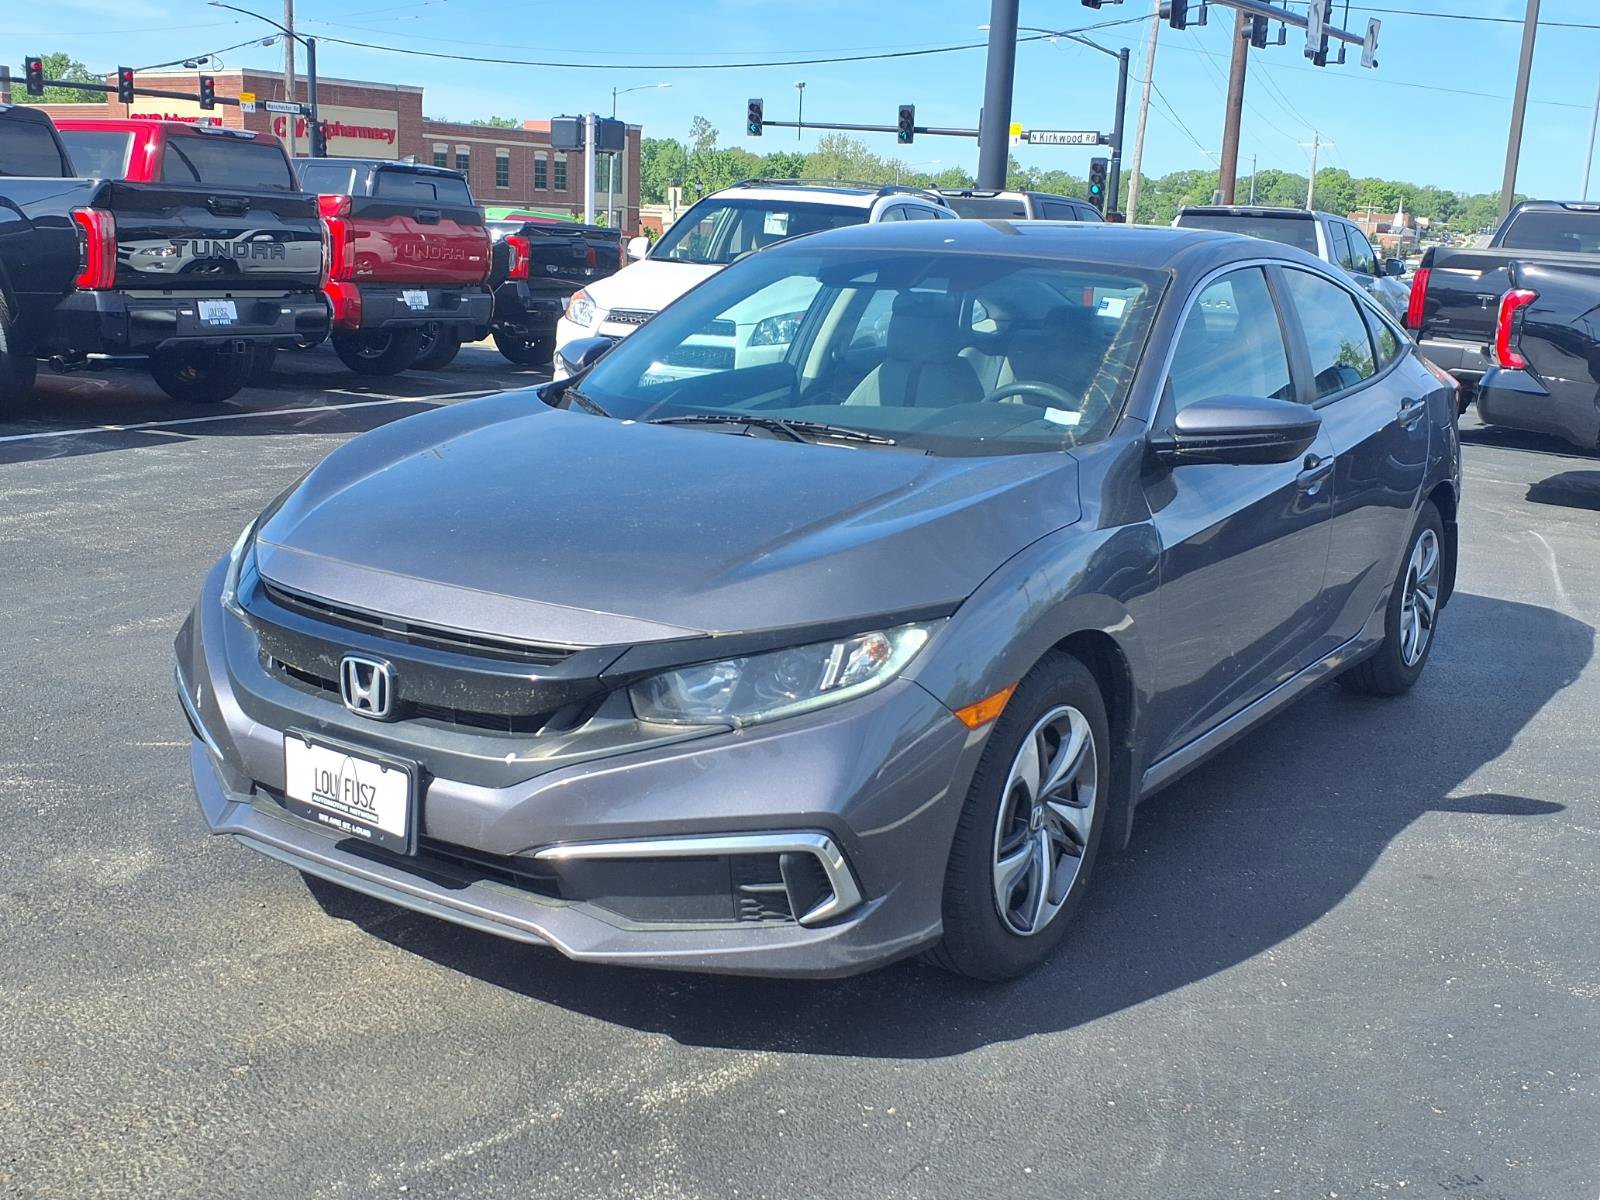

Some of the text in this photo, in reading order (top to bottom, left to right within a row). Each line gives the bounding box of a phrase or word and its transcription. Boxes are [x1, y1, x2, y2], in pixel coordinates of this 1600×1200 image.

[267, 103, 292, 112] Manchester
[1040, 132, 1083, 143] Kirkwood
[1086, 134, 1096, 142] Rd
[169, 239, 286, 260] TUNDRA
[314, 767, 377, 812] LOU FUSZ
[351, 824, 372, 838] LOUIS
